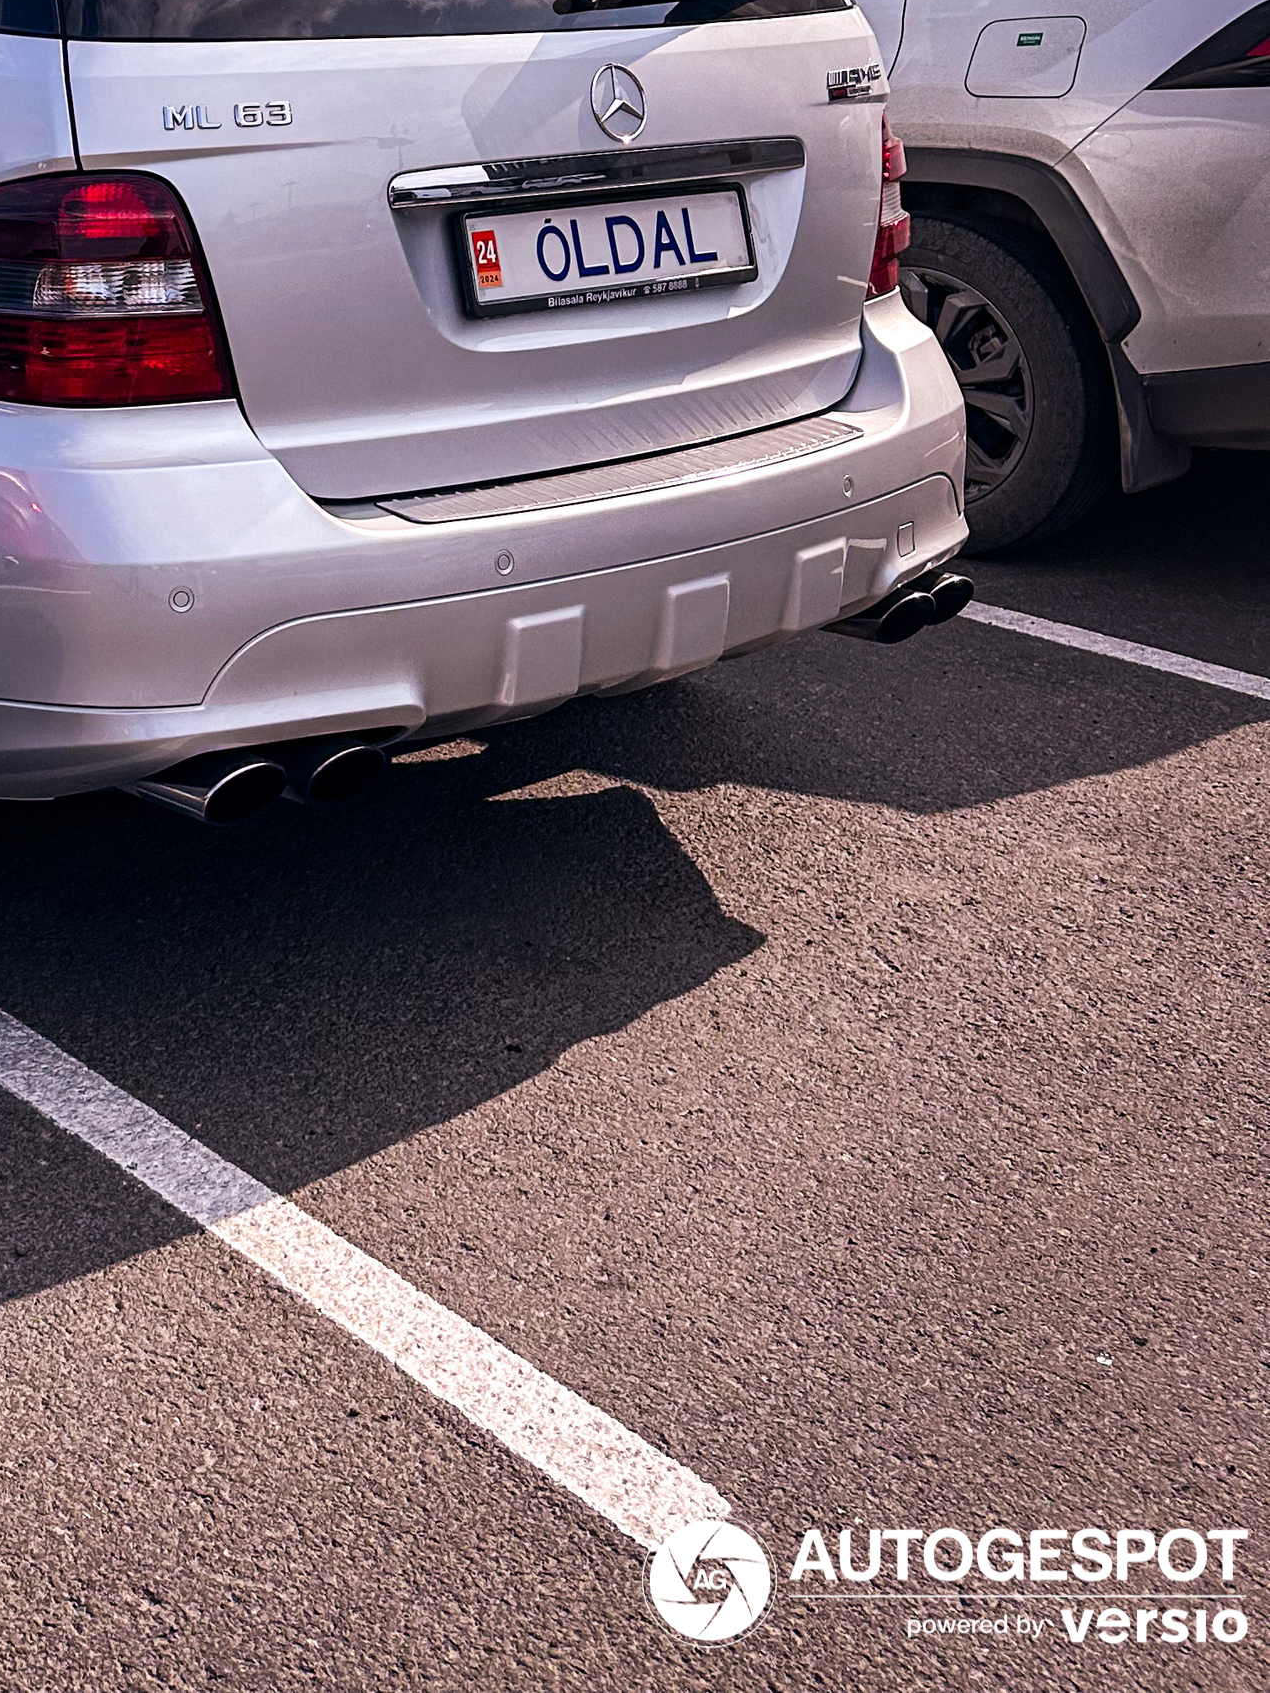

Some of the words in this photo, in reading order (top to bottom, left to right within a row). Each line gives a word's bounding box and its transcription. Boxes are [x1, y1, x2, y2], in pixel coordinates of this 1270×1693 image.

[162, 104, 222, 130] ML
[234, 100, 293, 127] 63
[477, 240, 497, 264] 24
[480, 274, 499, 284] 2024
